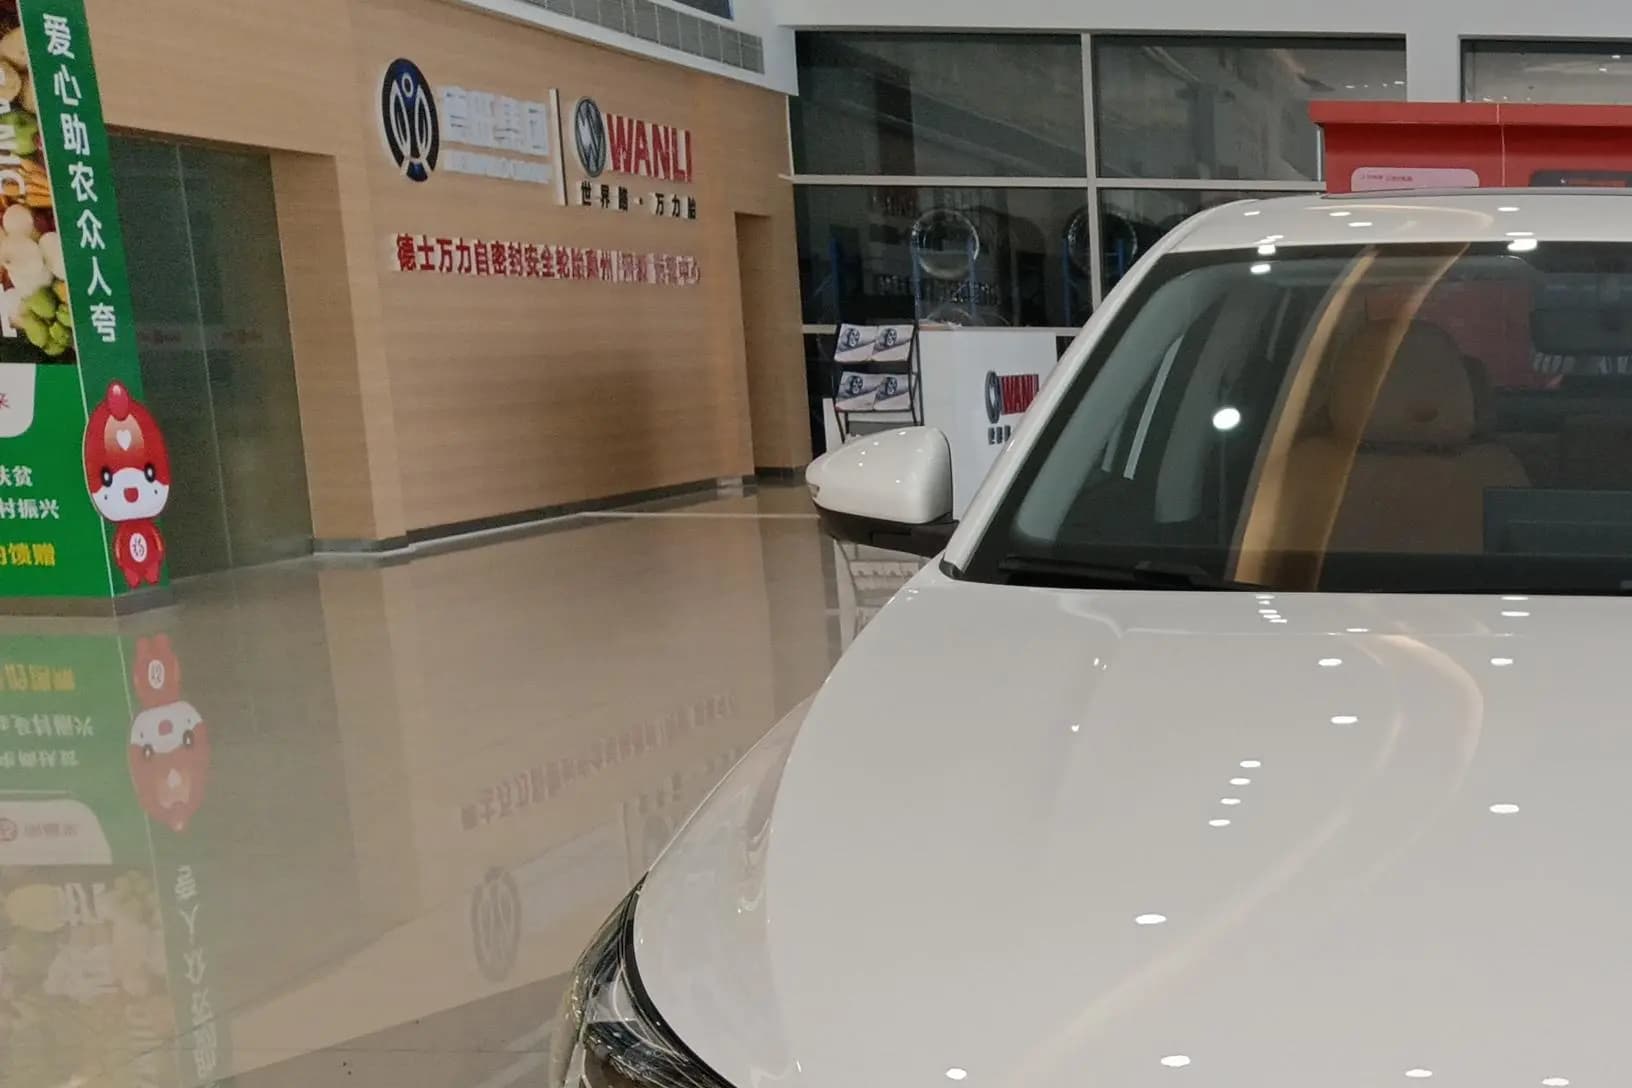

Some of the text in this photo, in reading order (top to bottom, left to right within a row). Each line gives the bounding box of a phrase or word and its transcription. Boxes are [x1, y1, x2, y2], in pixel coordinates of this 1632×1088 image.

[43, 14, 117, 343] 爱心助农众人夸
[606, 113, 693, 183] WANLI
